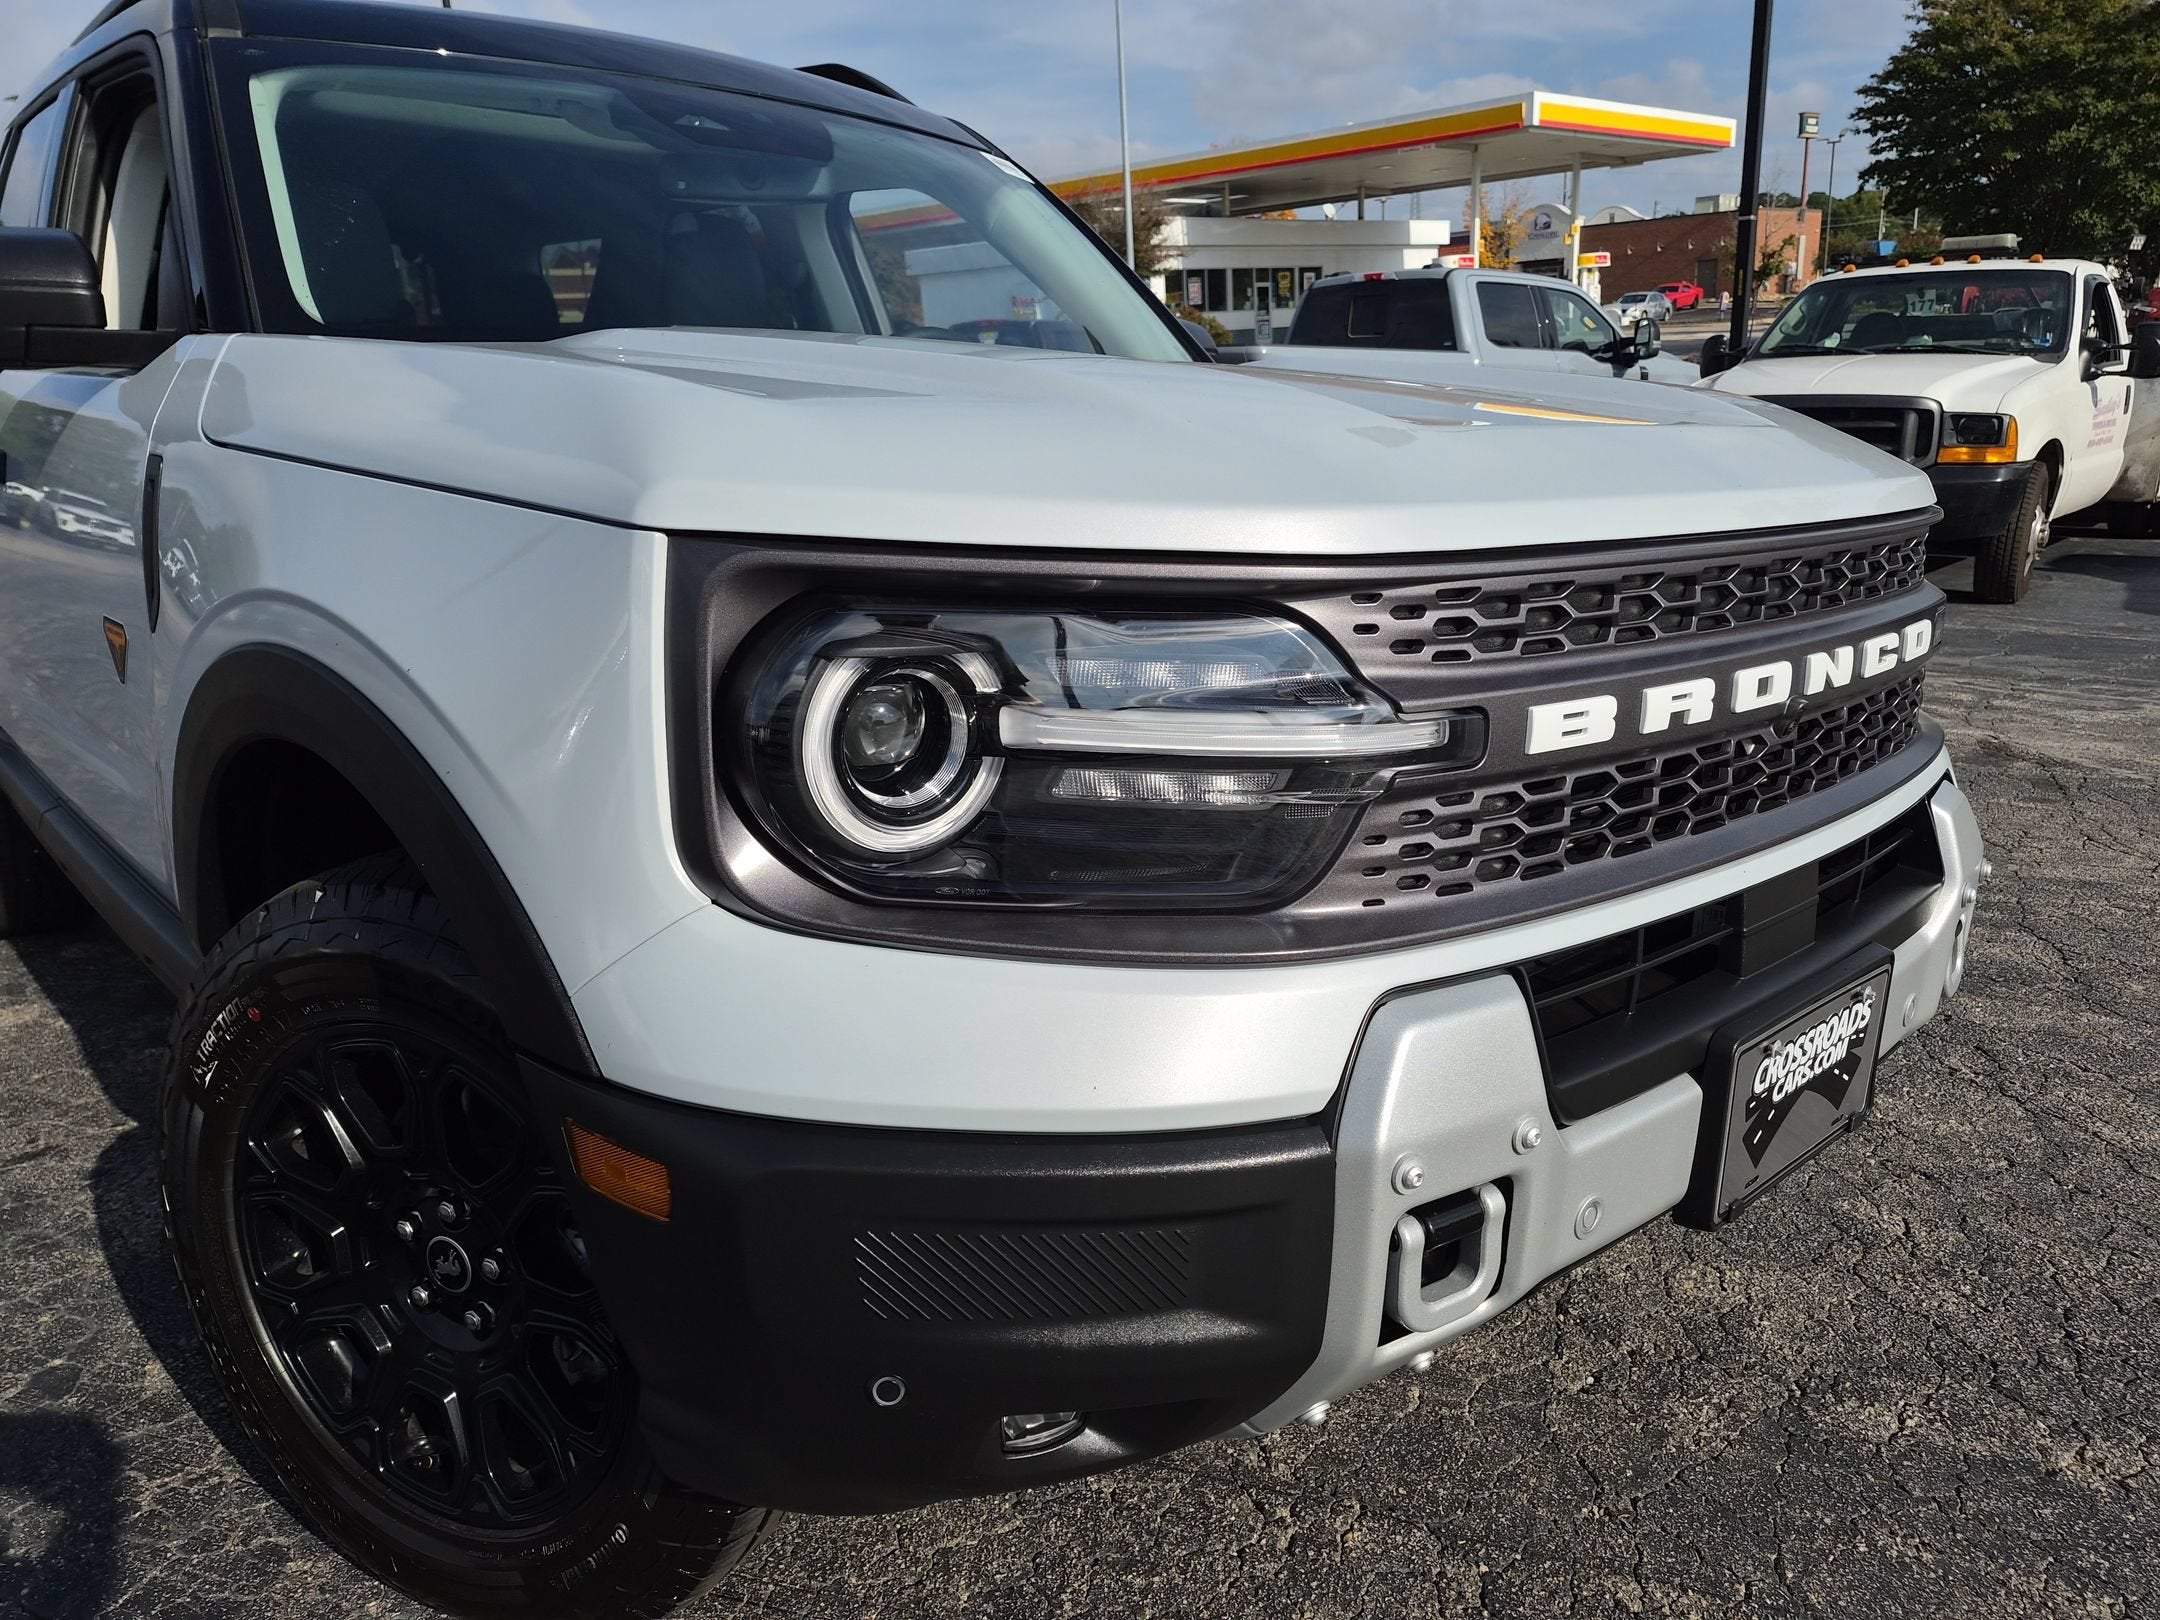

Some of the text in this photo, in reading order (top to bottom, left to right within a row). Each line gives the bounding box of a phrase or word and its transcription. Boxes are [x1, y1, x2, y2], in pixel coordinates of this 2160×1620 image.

[1909, 299, 1935, 312] 177
[1524, 618, 1932, 756] BRONCO
[195, 996, 245, 1063] TRACTION
[1753, 999, 1872, 1095] CROSSROADS
[1772, 1037, 1850, 1102] CARS.COM
